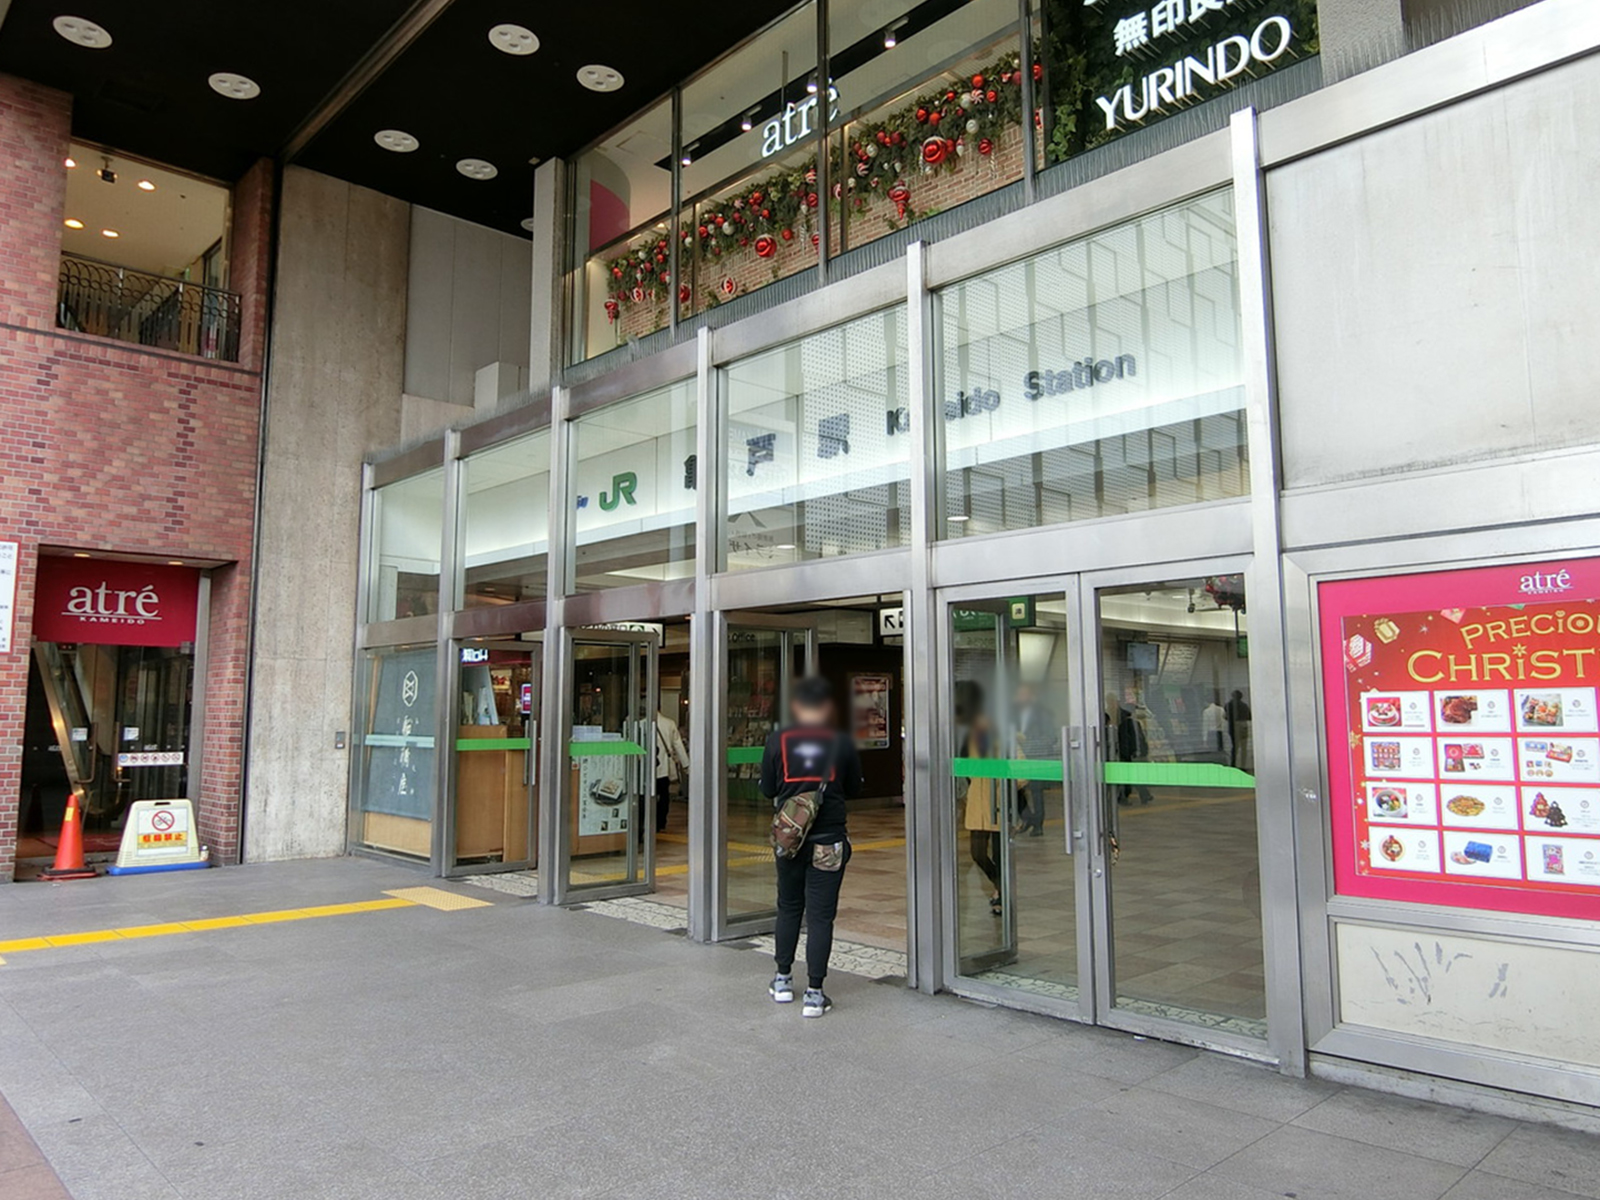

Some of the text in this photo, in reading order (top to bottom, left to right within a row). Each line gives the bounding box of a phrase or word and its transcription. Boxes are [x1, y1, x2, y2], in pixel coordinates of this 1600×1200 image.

[1095, 15, 1291, 130] YURINDO
[599, 471, 637, 512] JR
[1023, 353, 1137, 401] Station
[1520, 568, 1571, 591] atré
[67, 581, 160, 617] atré
[80, 616, 146, 625] KAMEIDO
